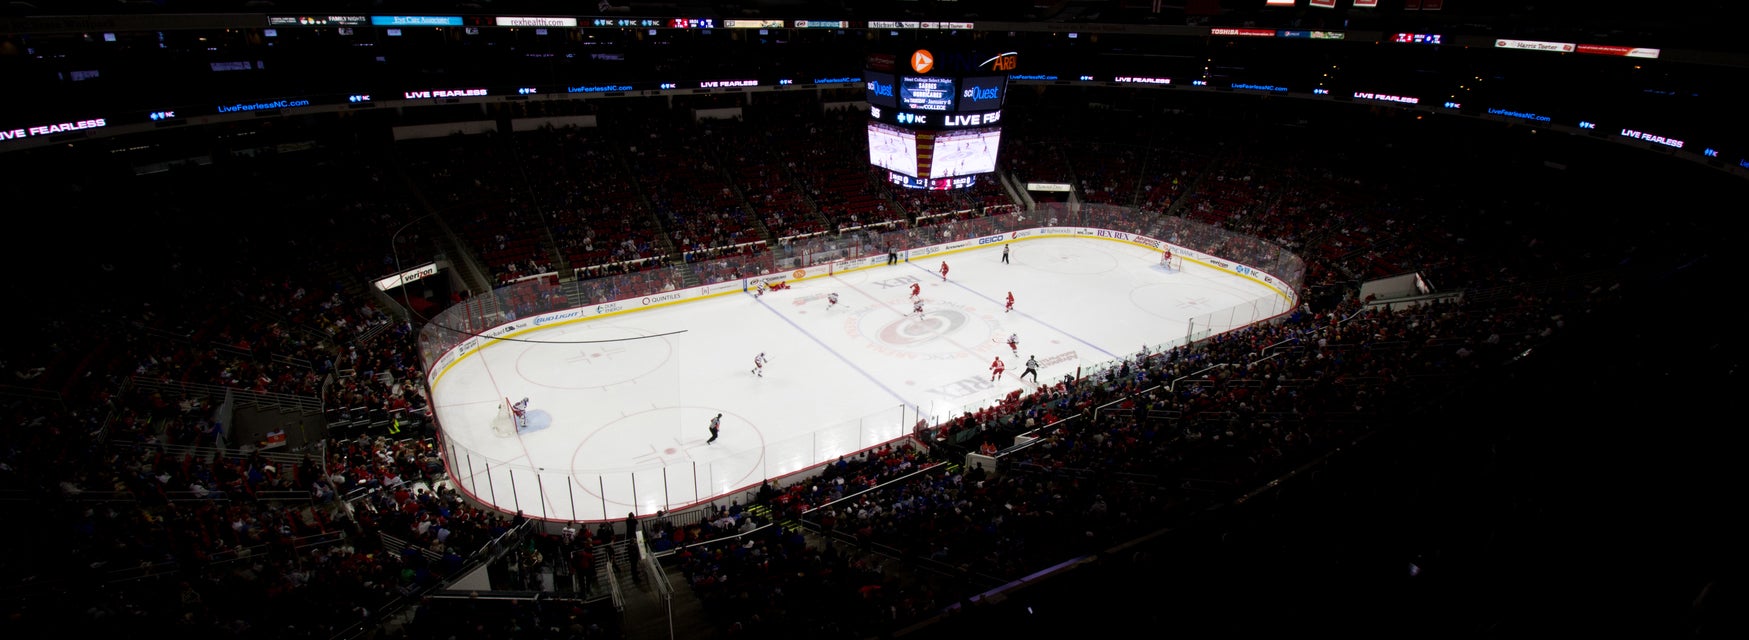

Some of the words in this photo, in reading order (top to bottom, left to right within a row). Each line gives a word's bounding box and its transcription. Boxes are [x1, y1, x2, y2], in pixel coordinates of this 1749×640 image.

[511, 17, 564, 26] rexhealth.com
[1211, 28, 1239, 36] TOSHIBA
[1132, 77, 1171, 85] FEARLESS
[567, 84, 633, 93] LiveFearlessNC.com
[867, 80, 893, 97] sciQuest
[1231, 83, 1288, 92] LiveFearlessNC.com
[433, 89, 487, 97] FEARLESS
[964, 85, 998, 102] sciQuest
[1354, 92, 1374, 100] LIVE
[1375, 94, 1419, 104] FEARLESS
[218, 99, 309, 113] LiveFearlessNC.com
[915, 115, 926, 124] NC
[1488, 107, 1551, 122] LiveFearlessNC.com
[945, 115, 980, 126] LIVE
[29, 119, 106, 136] FEARLESS
[1621, 129, 1641, 139] LIVE
[1641, 133, 1684, 149] FEARLESS
[978, 235, 1004, 245] GEICO
[1097, 229, 1112, 238] REX
[1114, 231, 1130, 241] REX
[1210, 259, 1229, 268] verizon
[404, 267, 433, 282] verizon
[1250, 270, 1259, 278] NC
[651, 293, 681, 303] QUINTILES
[553, 311, 579, 320] LIGHT
[922, 376, 994, 399] REX
